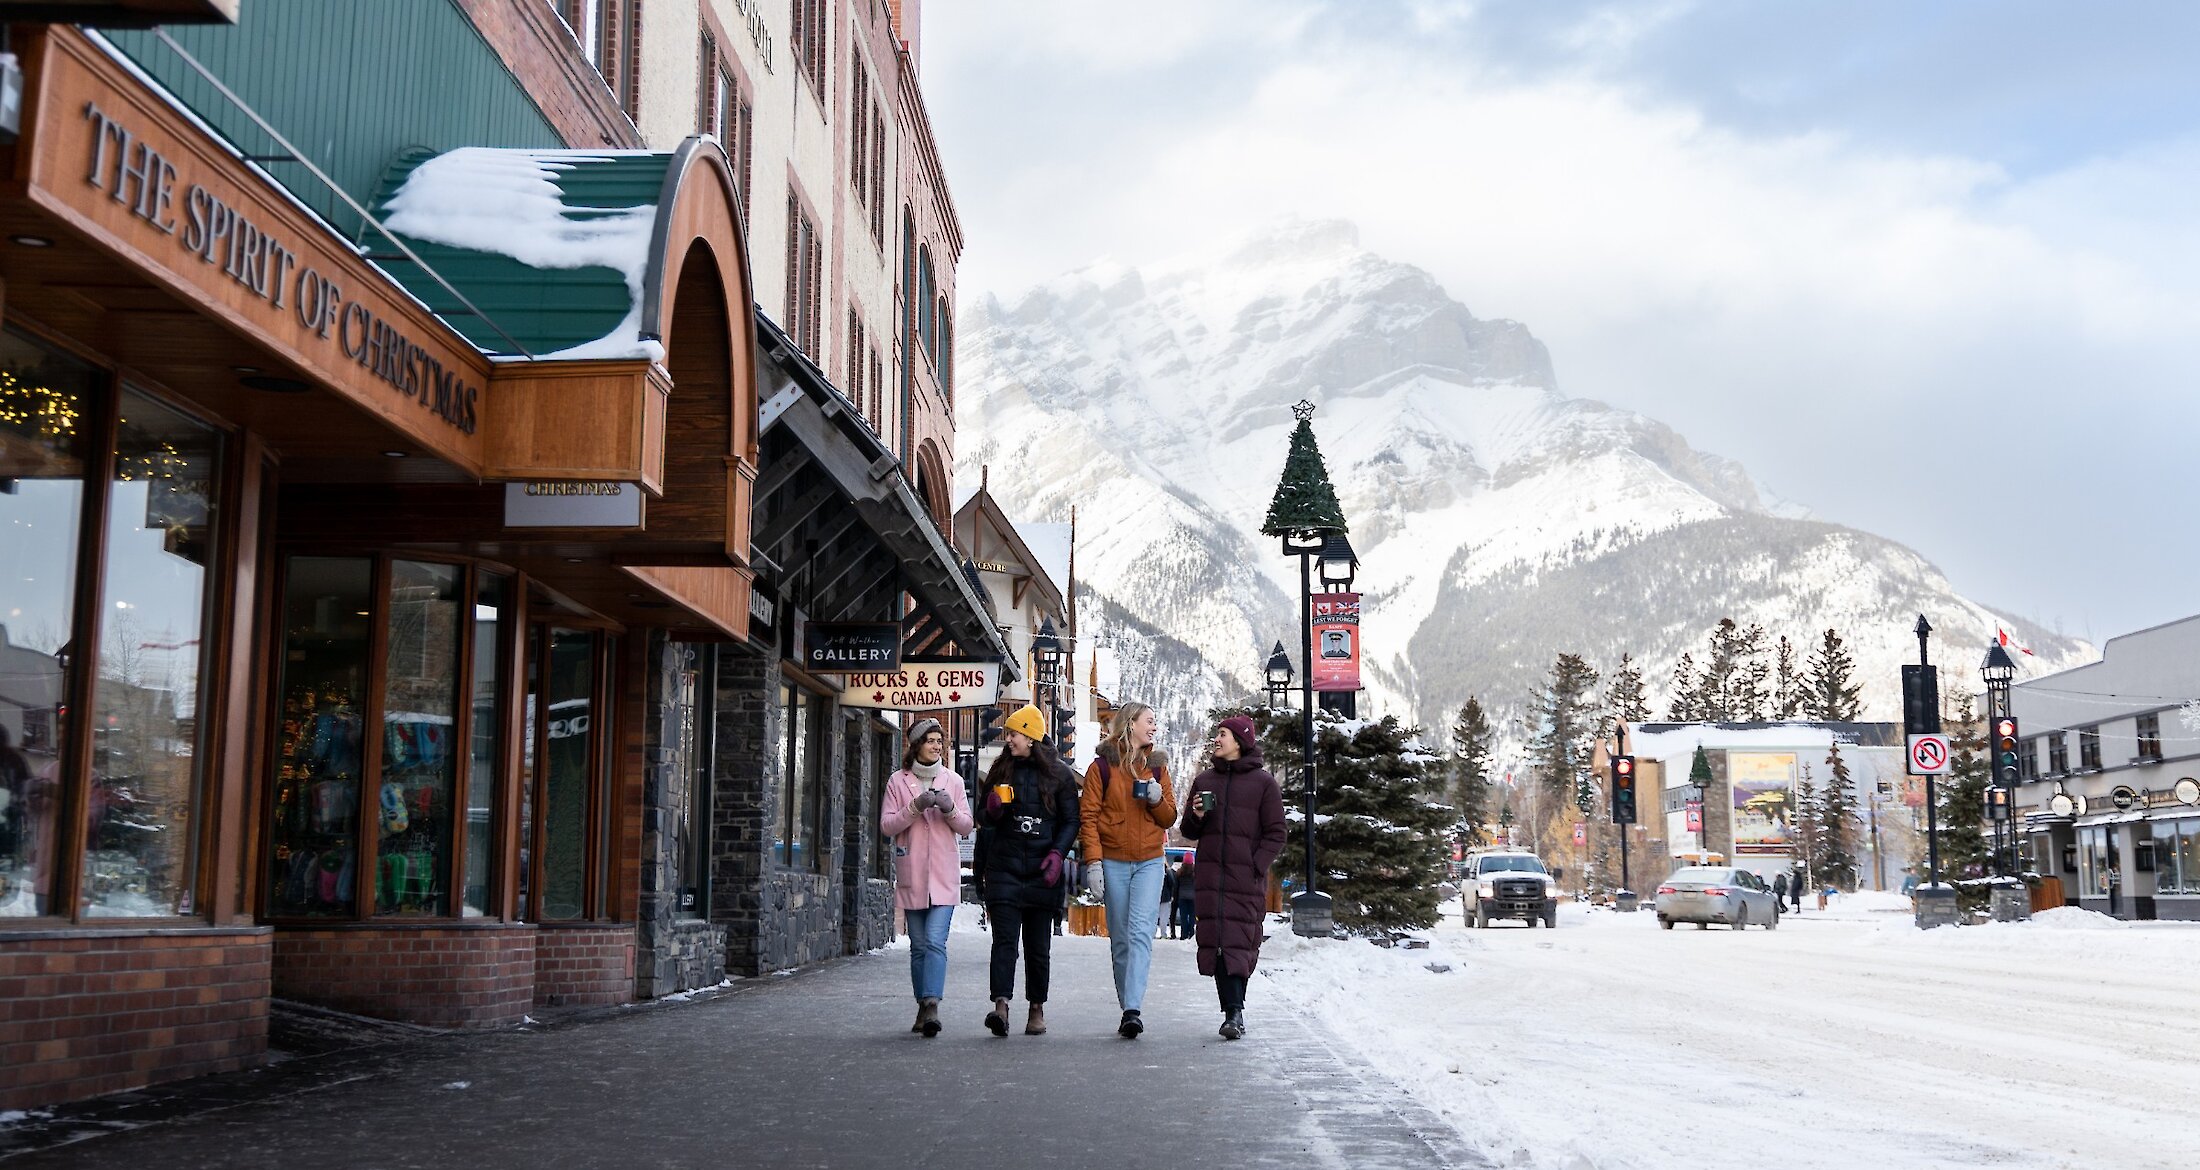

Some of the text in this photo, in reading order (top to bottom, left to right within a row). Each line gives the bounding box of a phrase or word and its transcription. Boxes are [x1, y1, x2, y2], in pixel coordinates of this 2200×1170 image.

[84, 102, 477, 435] THE SPIRIT OF CHRISTMAS
[523, 482, 621, 496] CHRISTMAS
[978, 561, 1007, 572] CENTRE
[812, 649, 891, 661] GALLERY
[850, 671, 908, 688] ROCKS
[916, 671, 929, 688] &
[937, 671, 984, 688] GEMS
[891, 691, 942, 706] CANADA
